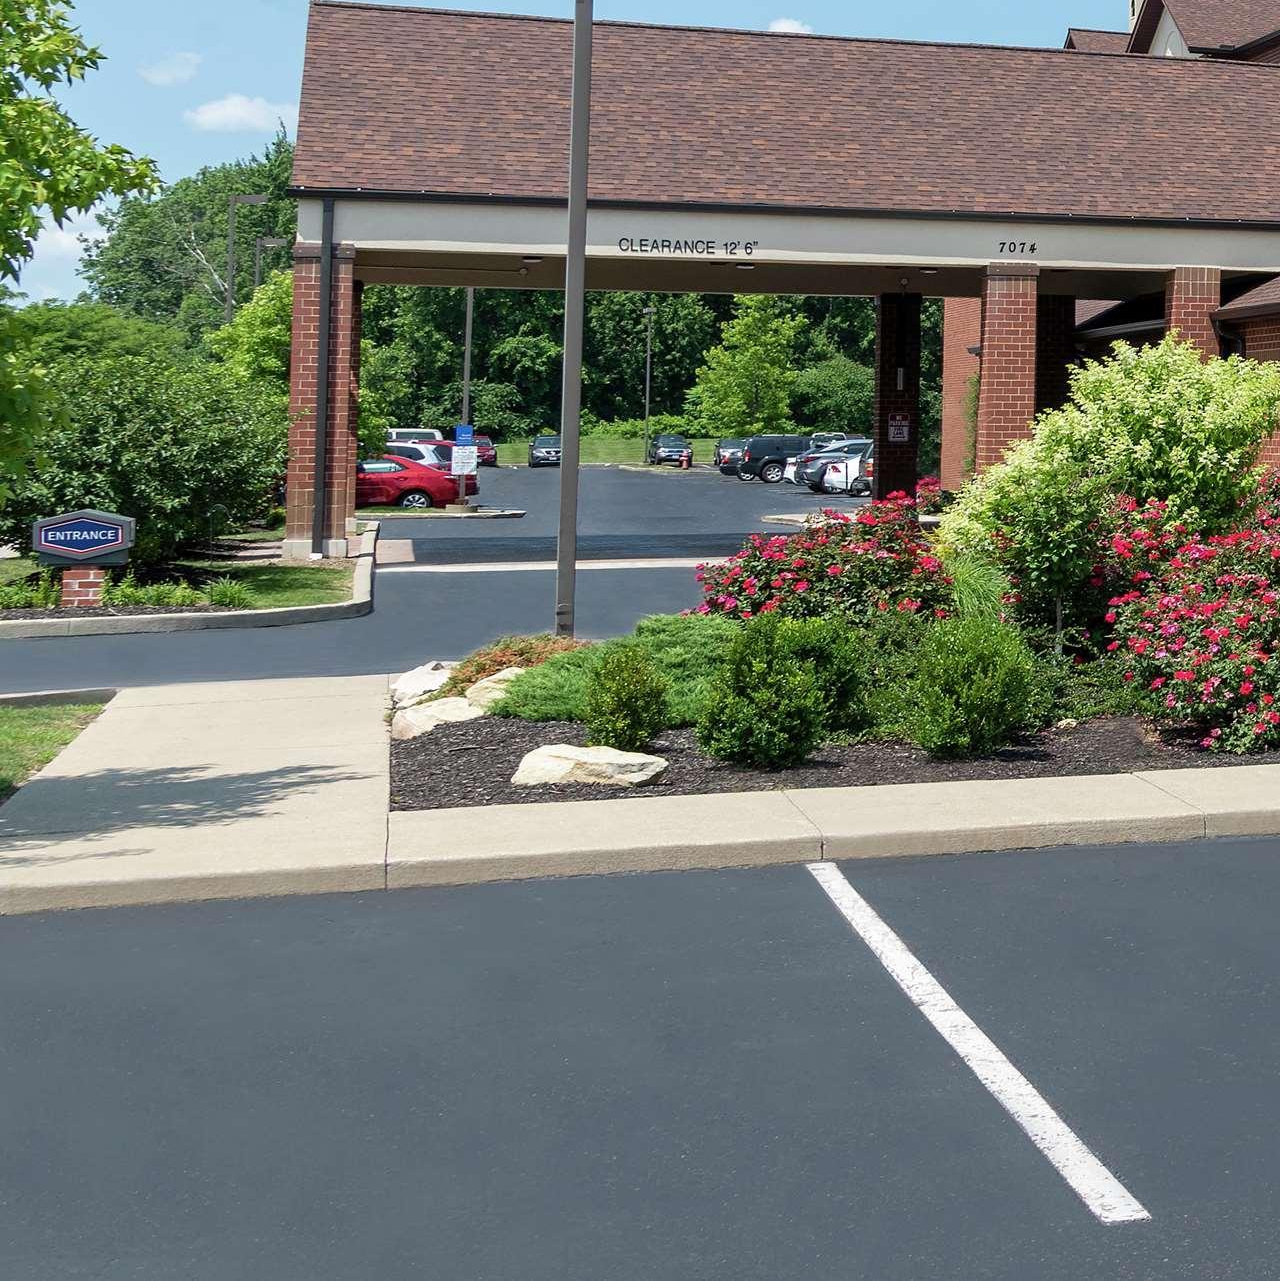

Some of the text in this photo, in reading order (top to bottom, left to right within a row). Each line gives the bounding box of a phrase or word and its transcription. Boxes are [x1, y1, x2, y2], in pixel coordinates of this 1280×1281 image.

[618, 237, 716, 255] CLEARANCE
[722, 240, 741, 255] 12'
[998, 241, 1038, 254] 7074
[47, 529, 116, 541] ENTRANCE
